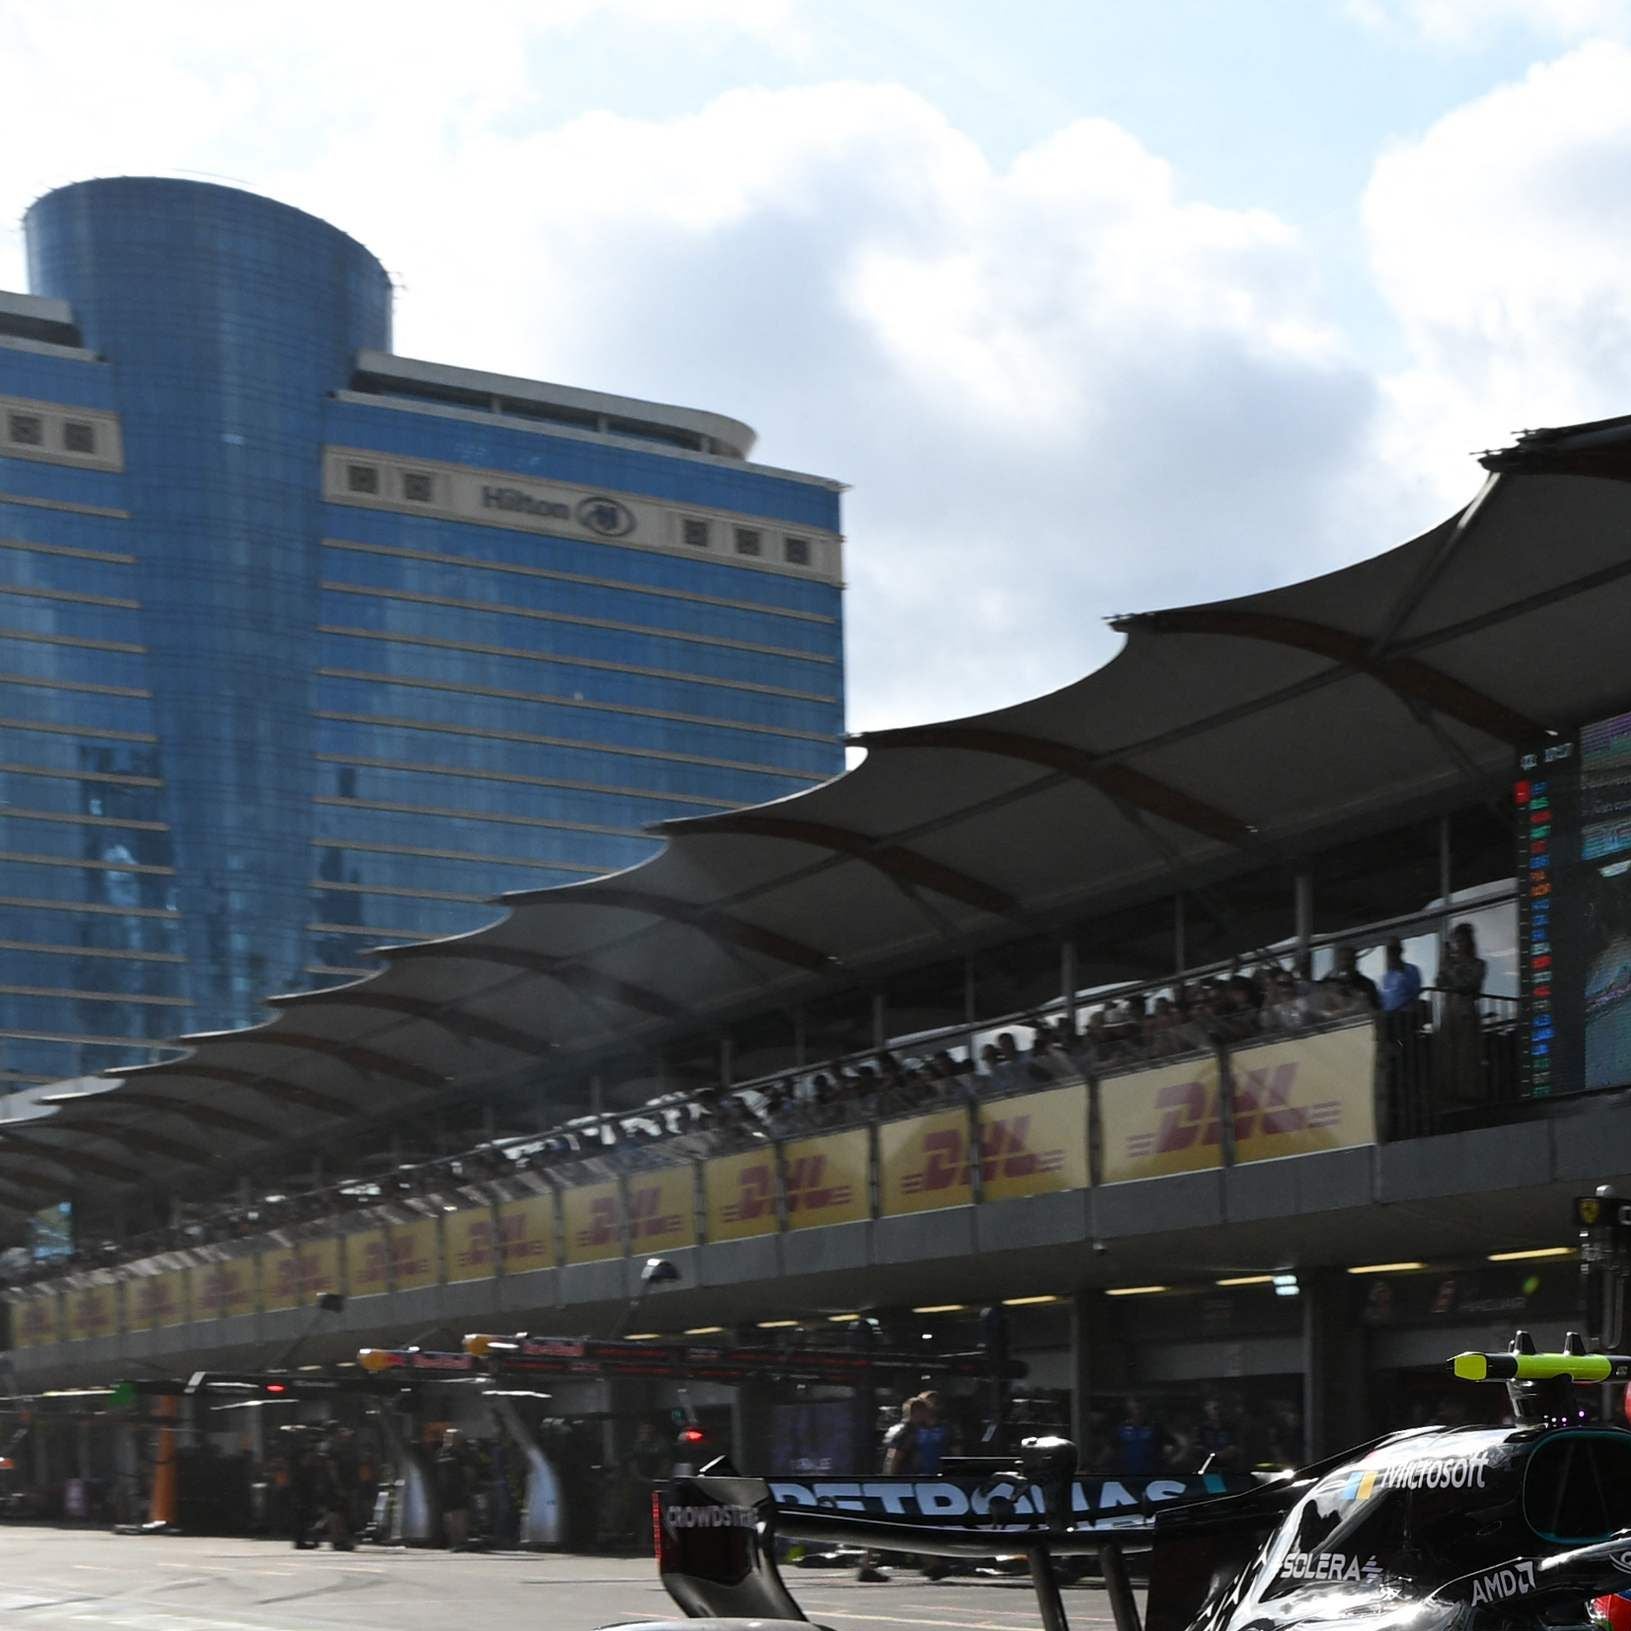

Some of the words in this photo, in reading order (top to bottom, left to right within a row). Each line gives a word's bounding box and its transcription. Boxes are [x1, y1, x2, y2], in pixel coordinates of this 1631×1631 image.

[481, 485, 571, 524] Hilton
[1155, 1063, 1307, 1154] DHL
[921, 1114, 1045, 1192] DHL
[738, 1155, 832, 1218] DHL
[1380, 1450, 1490, 1490] Microsoft
[1280, 1552, 1361, 1581] SOLERA
[1470, 1570, 1518, 1608] AMD
